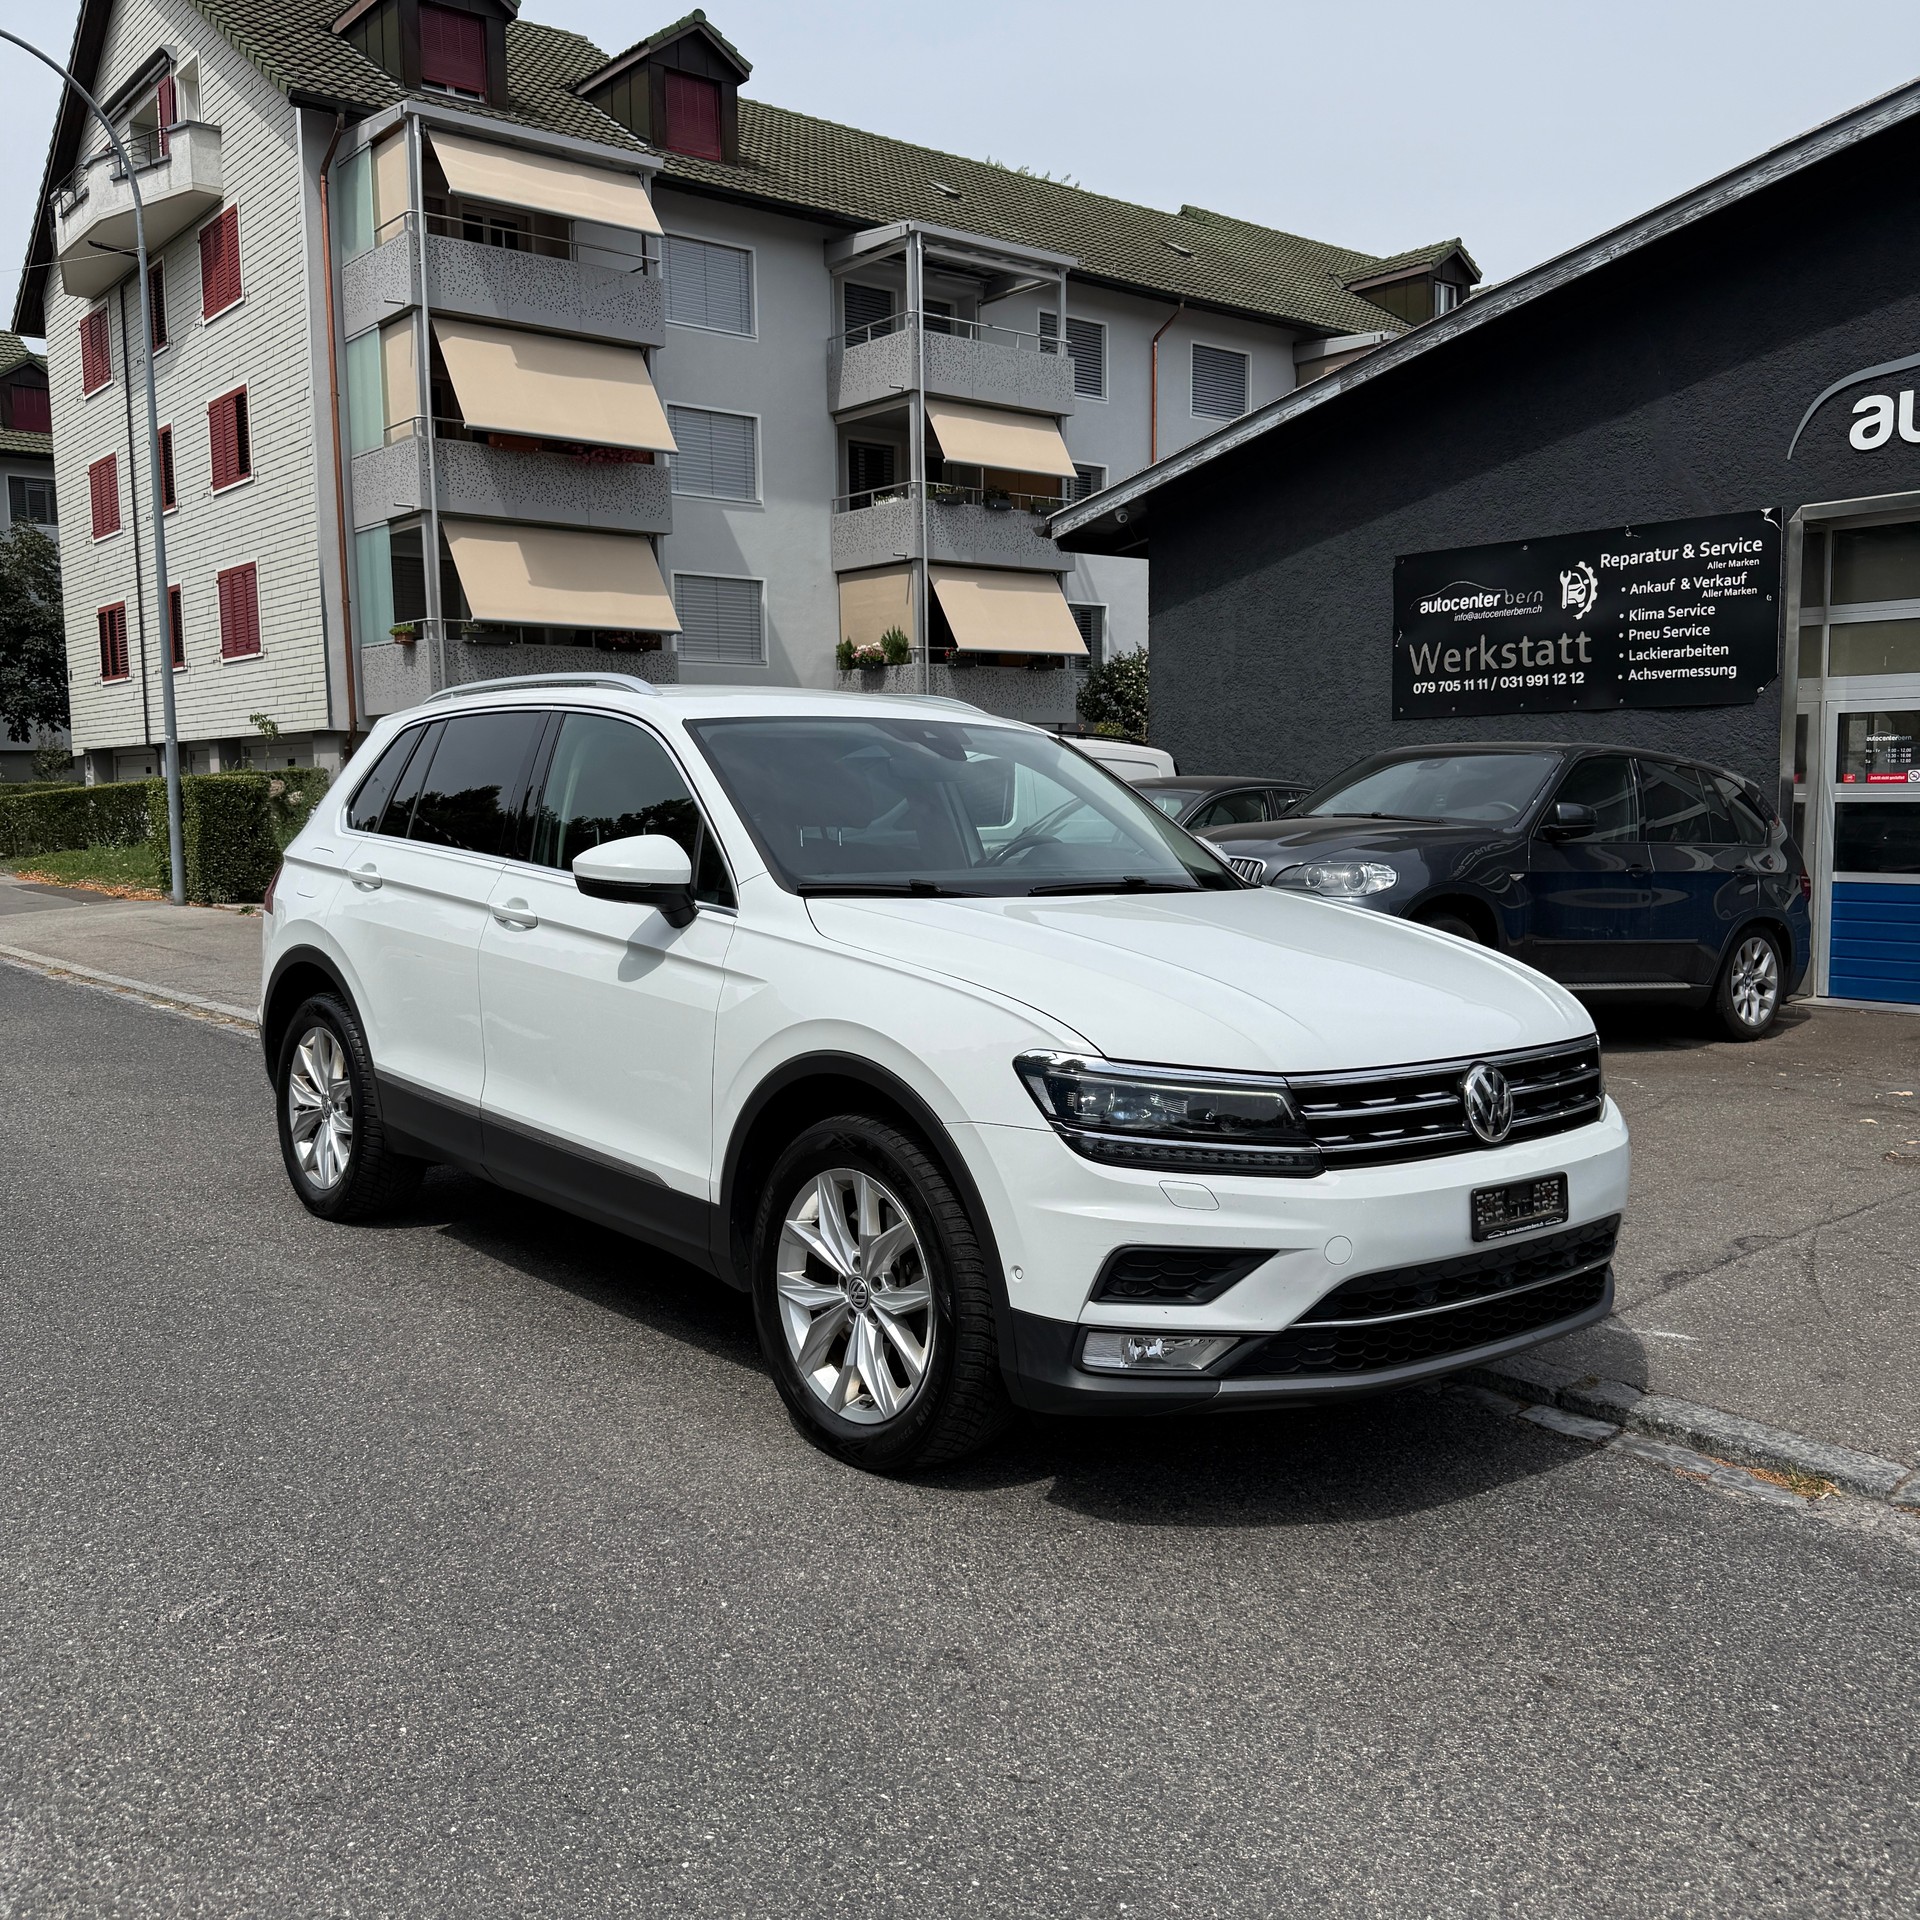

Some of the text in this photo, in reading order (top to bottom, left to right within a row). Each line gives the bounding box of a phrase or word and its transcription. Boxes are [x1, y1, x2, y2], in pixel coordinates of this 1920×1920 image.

[1600, 537, 1763, 571] Reparatur & Service
[1707, 558, 1760, 570] Aller Marken
[1630, 571, 1748, 595] Ankauf & Verkauf
[1702, 586, 1758, 599] Aller Marken
[1453, 604, 1543, 622] info@autocenterbern.ch
[1629, 603, 1716, 621] Klima Service
[1628, 623, 1711, 641] Pneu Service
[1409, 631, 1592, 676] Werkstatt
[1628, 643, 1730, 662] Lackierarbeiten
[1628, 665, 1738, 681] Achsvermessung
[1413, 682, 1436, 694] 079
[1438, 680, 1461, 693] 705
[1490, 676, 1498, 691] /
[1500, 675, 1523, 689] 031
[1526, 674, 1549, 687] 991
[1552, 672, 1567, 685] 12
[1569, 671, 1585, 684] 12
